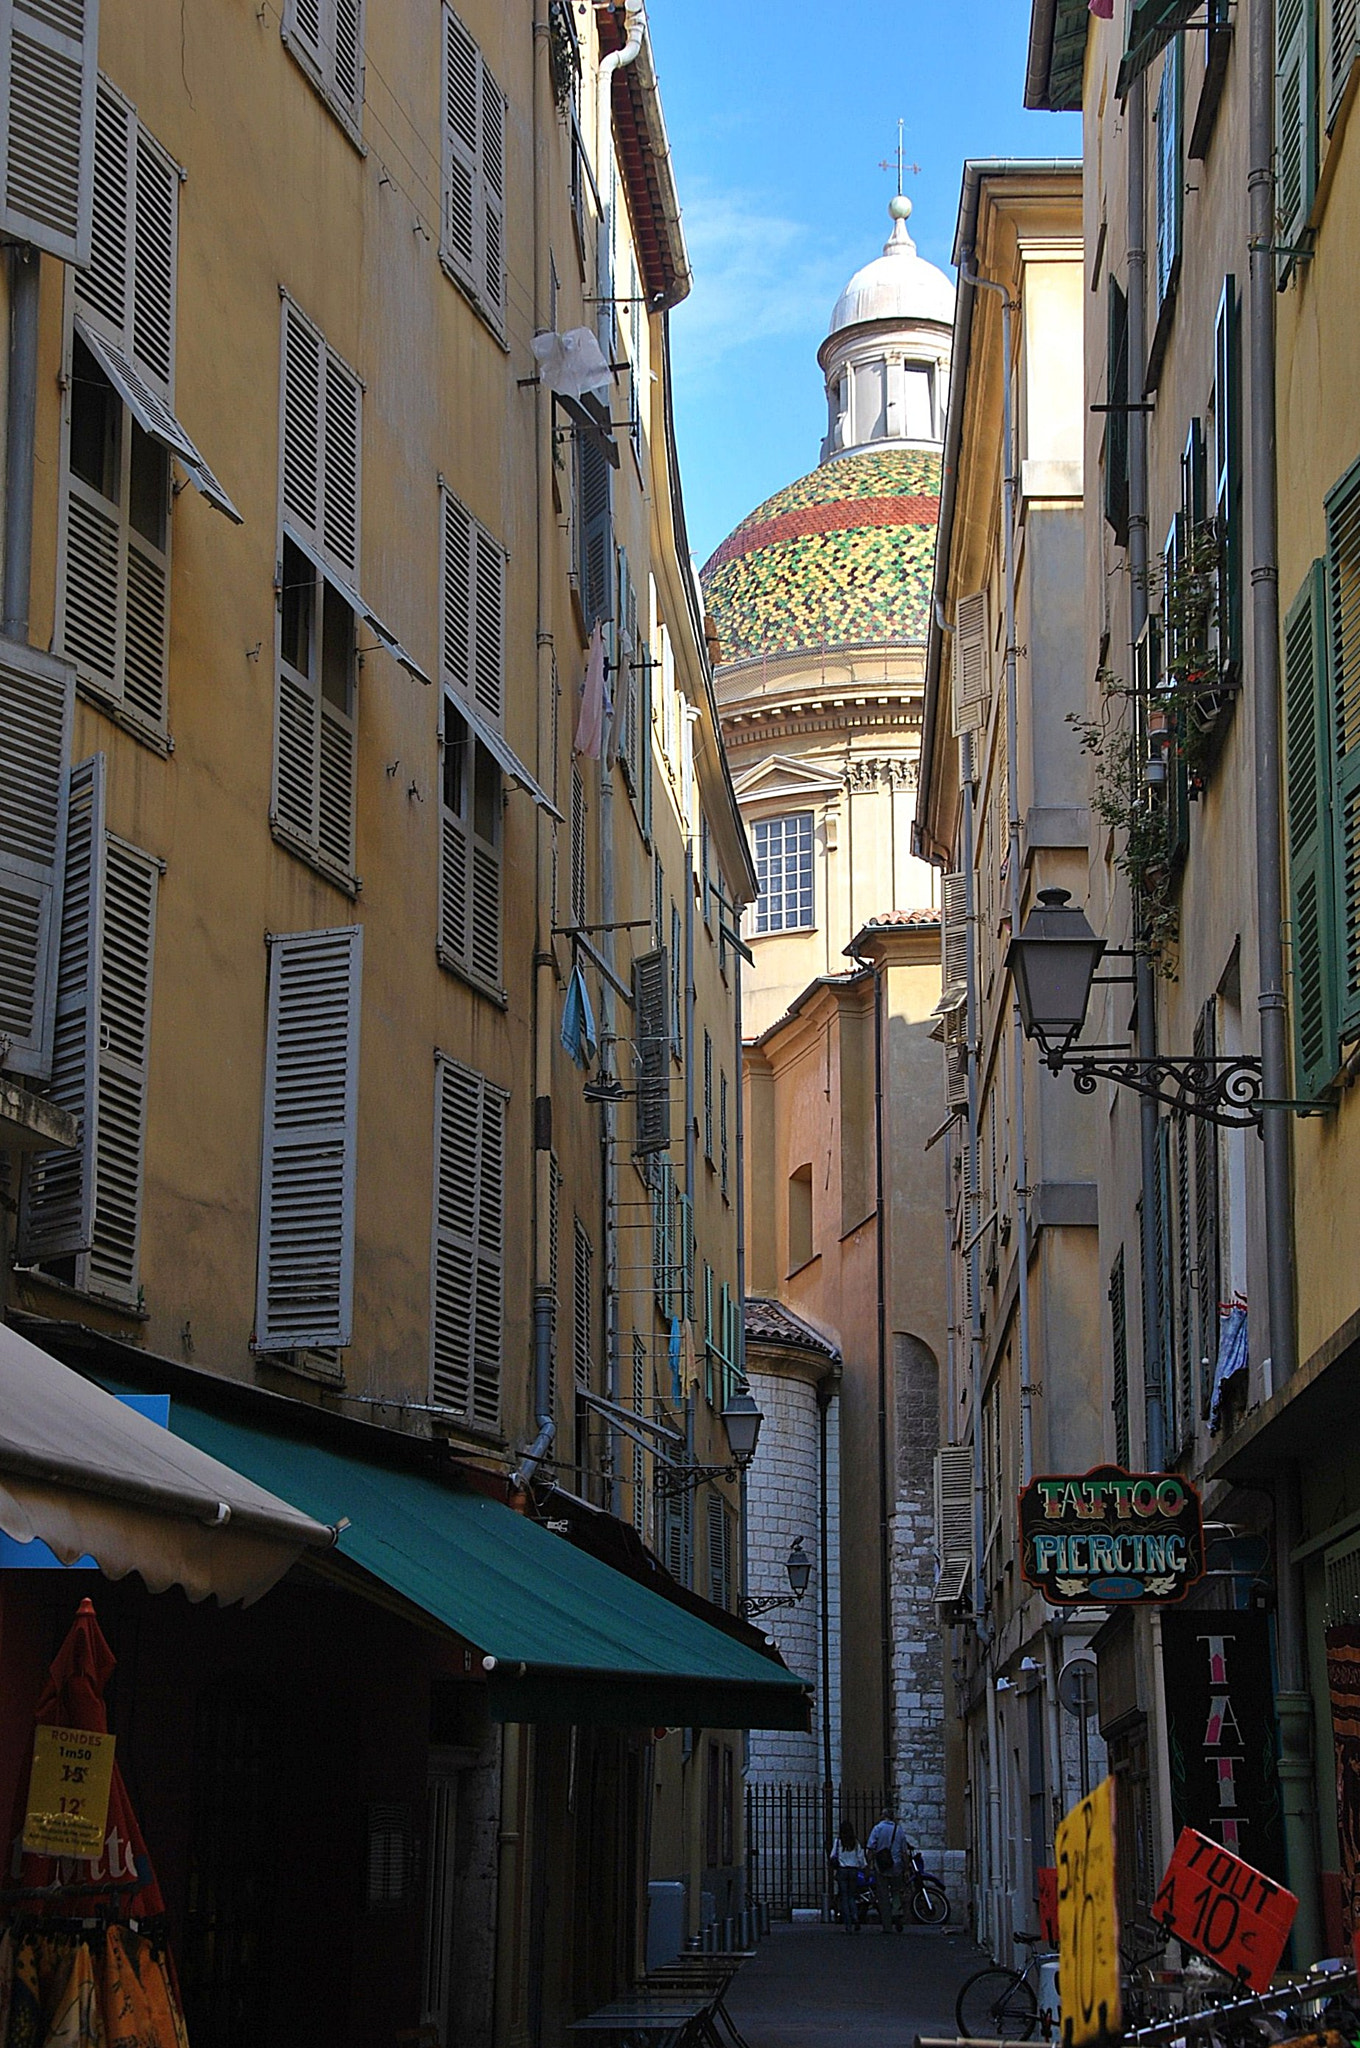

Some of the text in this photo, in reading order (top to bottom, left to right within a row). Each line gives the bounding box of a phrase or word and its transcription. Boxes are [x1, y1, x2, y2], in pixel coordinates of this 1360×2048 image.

[1037, 1479, 1188, 1519] TATTOO
[1033, 1534, 1187, 1574] PIERCING
[51, 1730, 102, 1746] RONDES
[59, 1746, 92, 1760] 1m50
[1188, 1836, 1278, 1913] TOUT
